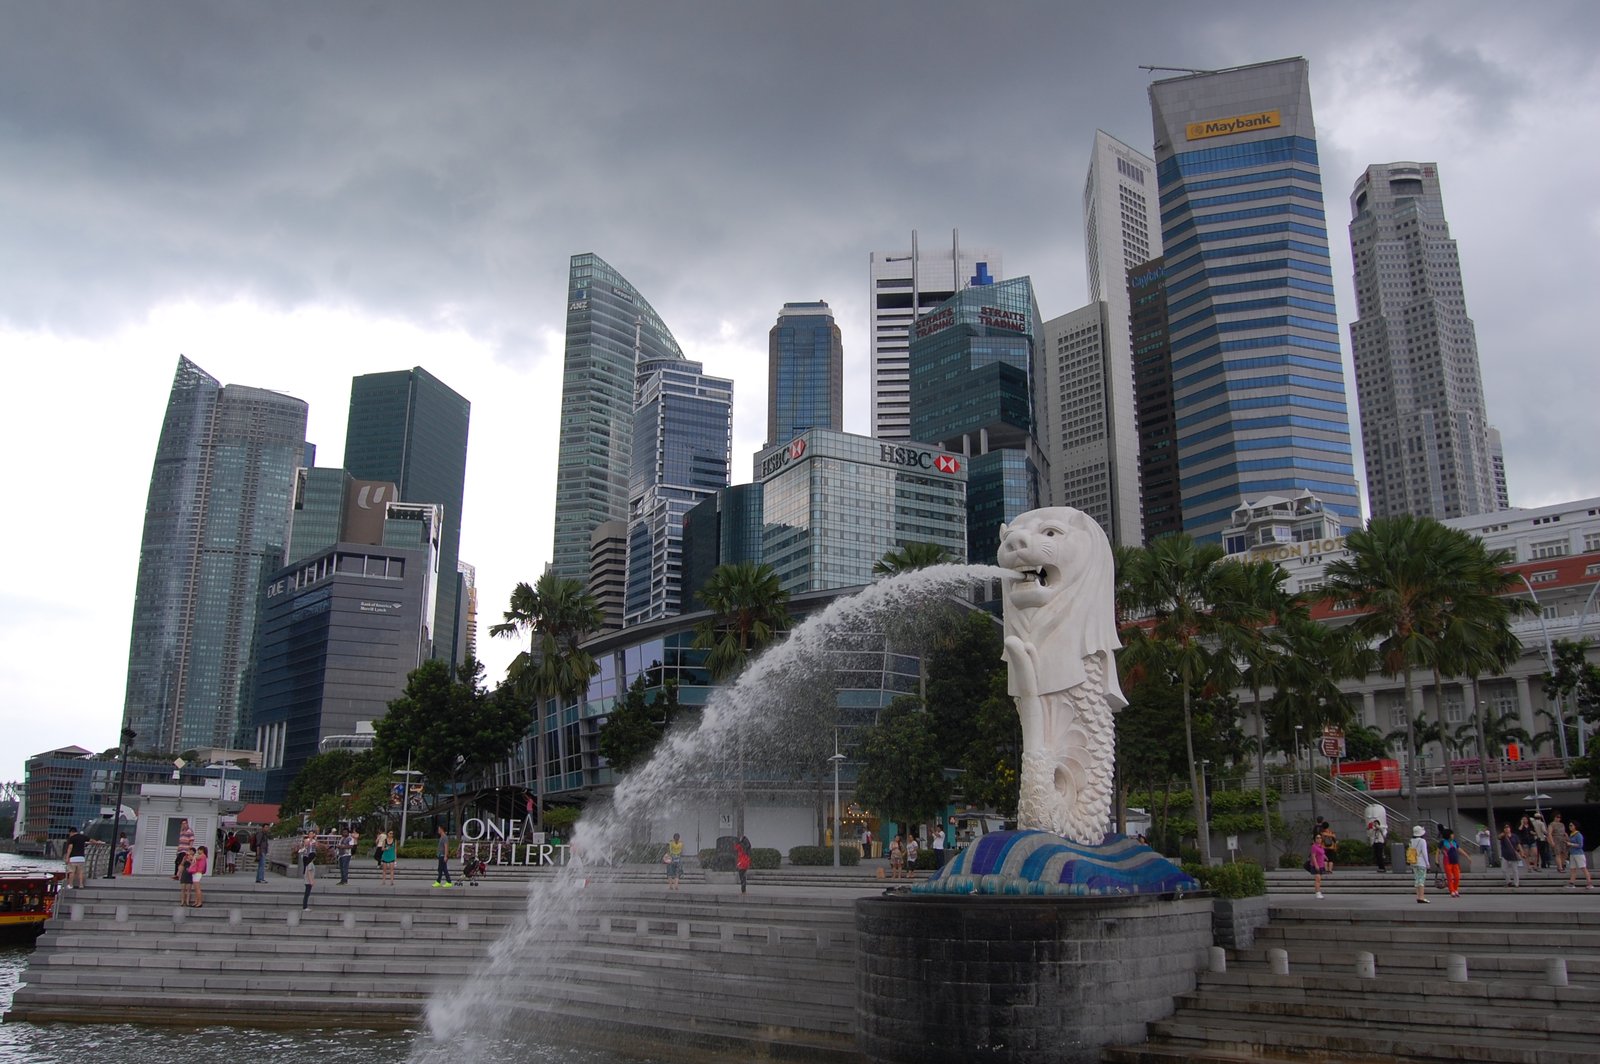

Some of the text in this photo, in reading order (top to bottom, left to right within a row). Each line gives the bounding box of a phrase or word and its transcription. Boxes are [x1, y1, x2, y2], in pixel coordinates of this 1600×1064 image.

[1205, 114, 1271, 133] Maybank
[613, 287, 632, 301] Keppel
[916, 307, 953, 329] STRAITS
[978, 315, 1025, 332] TRADING
[981, 306, 1025, 322] STRAITS
[916, 316, 955, 337] TRADING
[762, 445, 790, 478] HSBC
[879, 444, 932, 469] HSBC
[462, 818, 521, 840] ONE
[460, 843, 613, 865] FULLERTN
